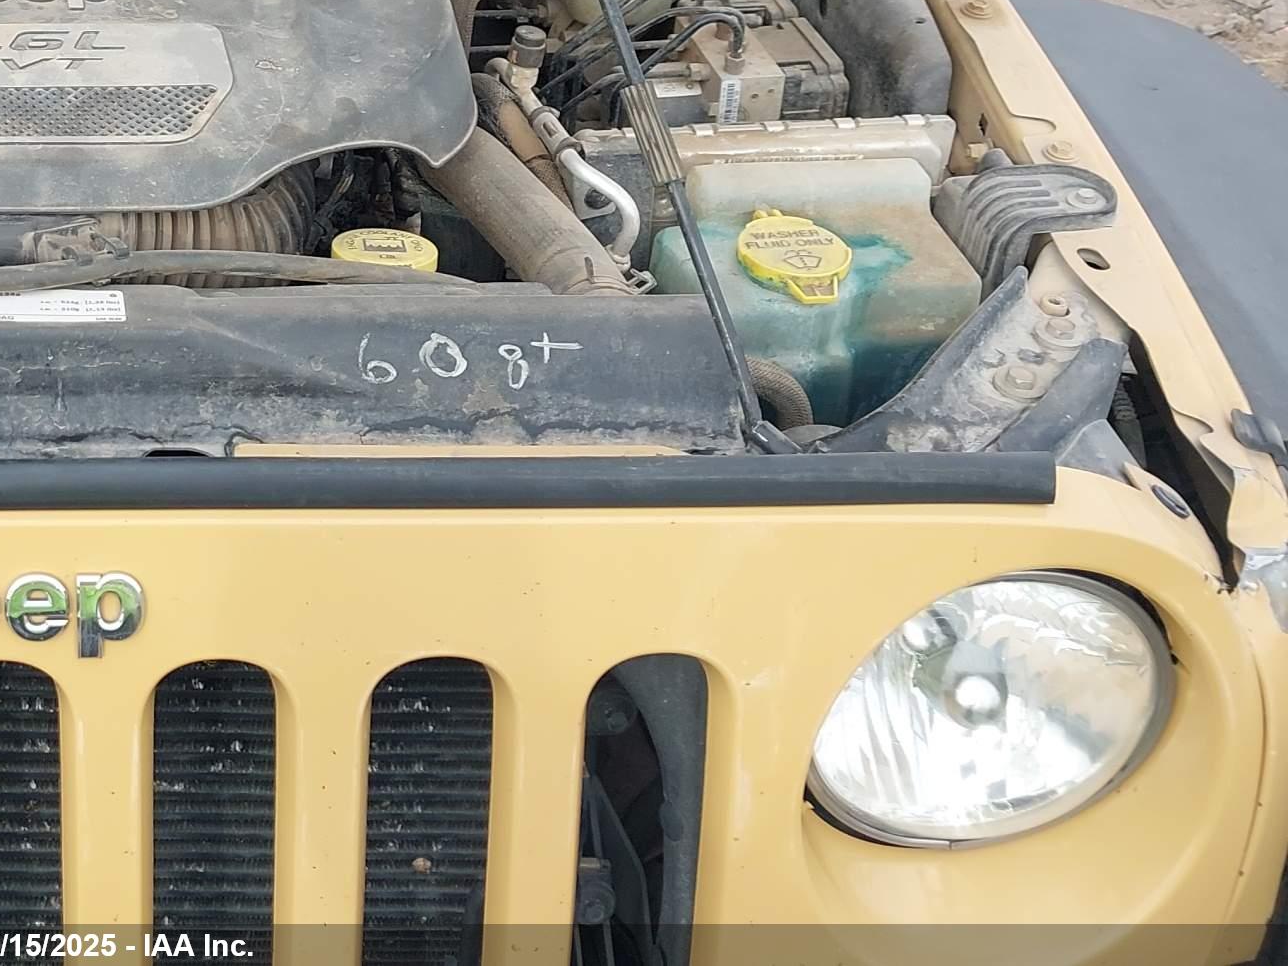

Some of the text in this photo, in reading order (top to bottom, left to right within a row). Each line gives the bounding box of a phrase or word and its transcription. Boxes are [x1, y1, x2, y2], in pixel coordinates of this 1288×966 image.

[750, 229, 821, 240] WASHER
[744, 237, 834, 250] FLUID ONLY
